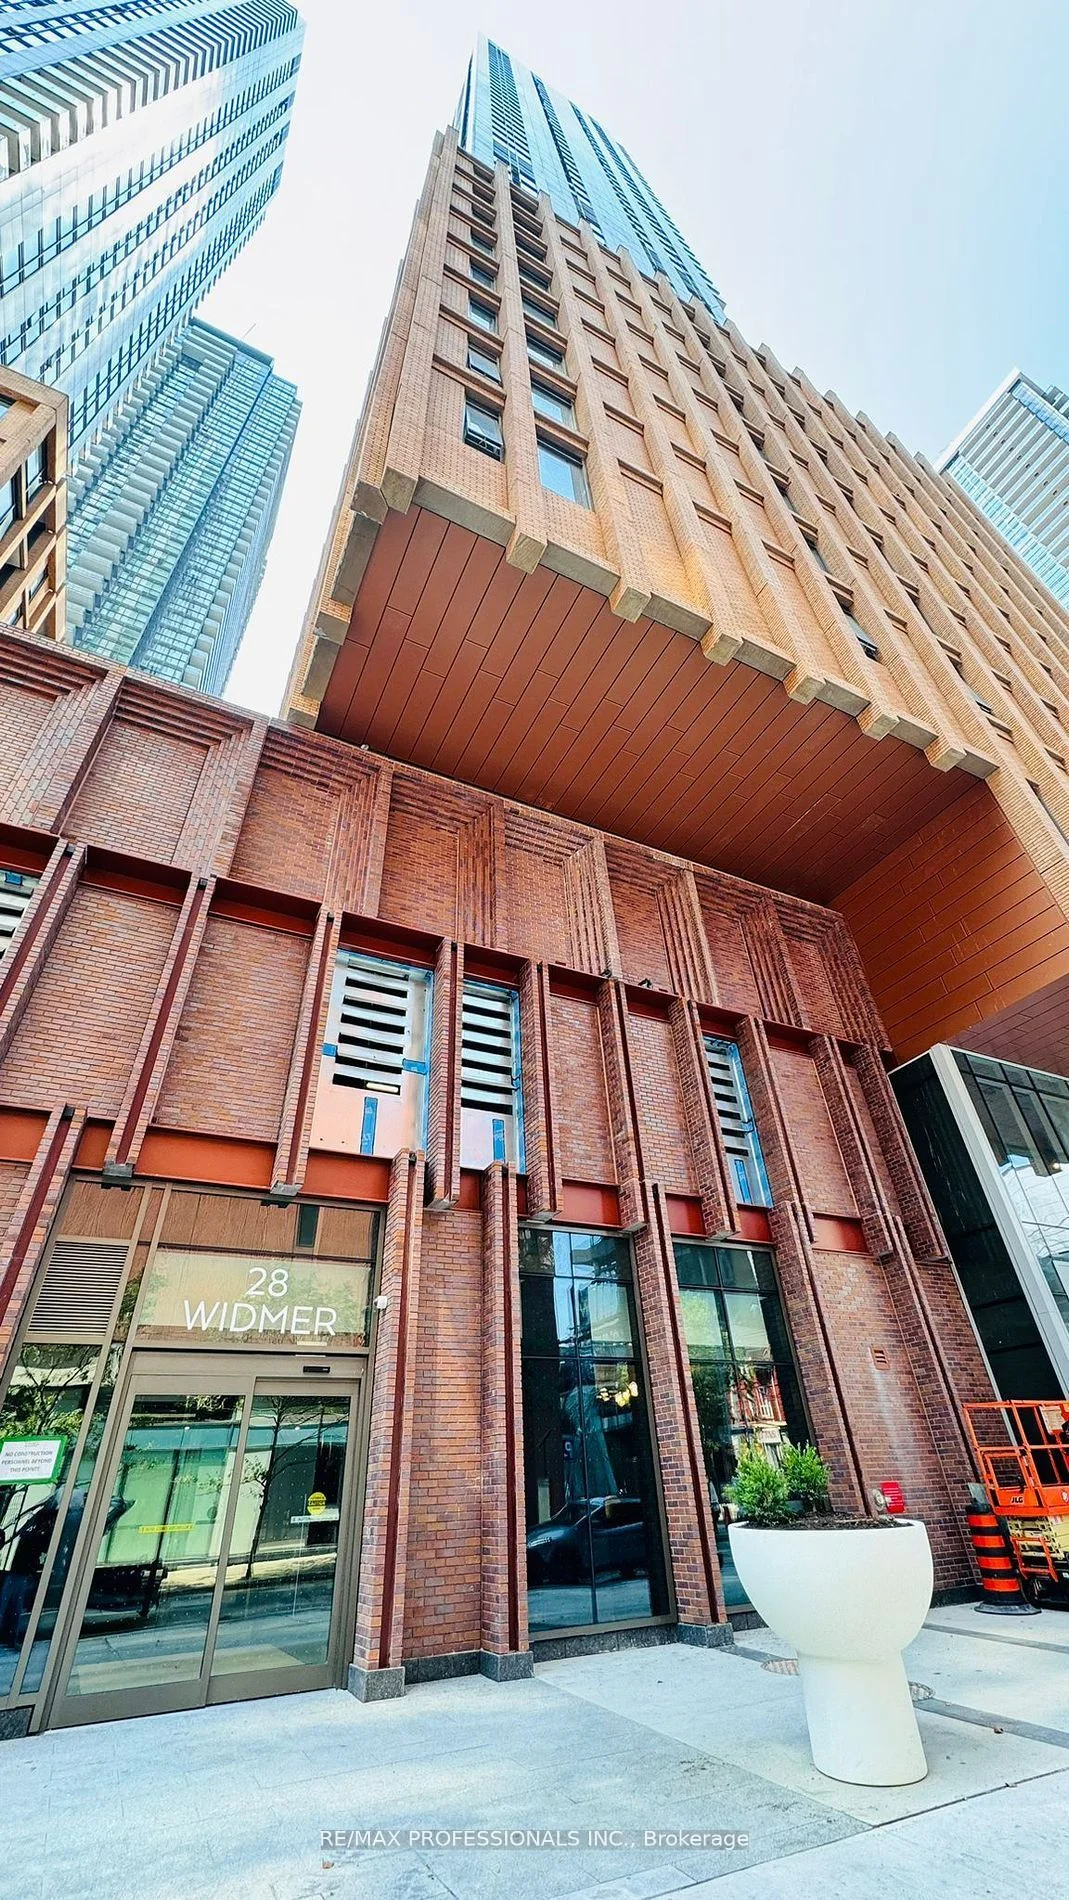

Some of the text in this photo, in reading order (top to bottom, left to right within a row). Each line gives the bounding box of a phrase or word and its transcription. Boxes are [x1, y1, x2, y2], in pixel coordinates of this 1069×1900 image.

[246, 1267, 288, 1297] 28
[184, 1300, 337, 1336] WIDMER
[1011, 1496, 1024, 1504] JLG
